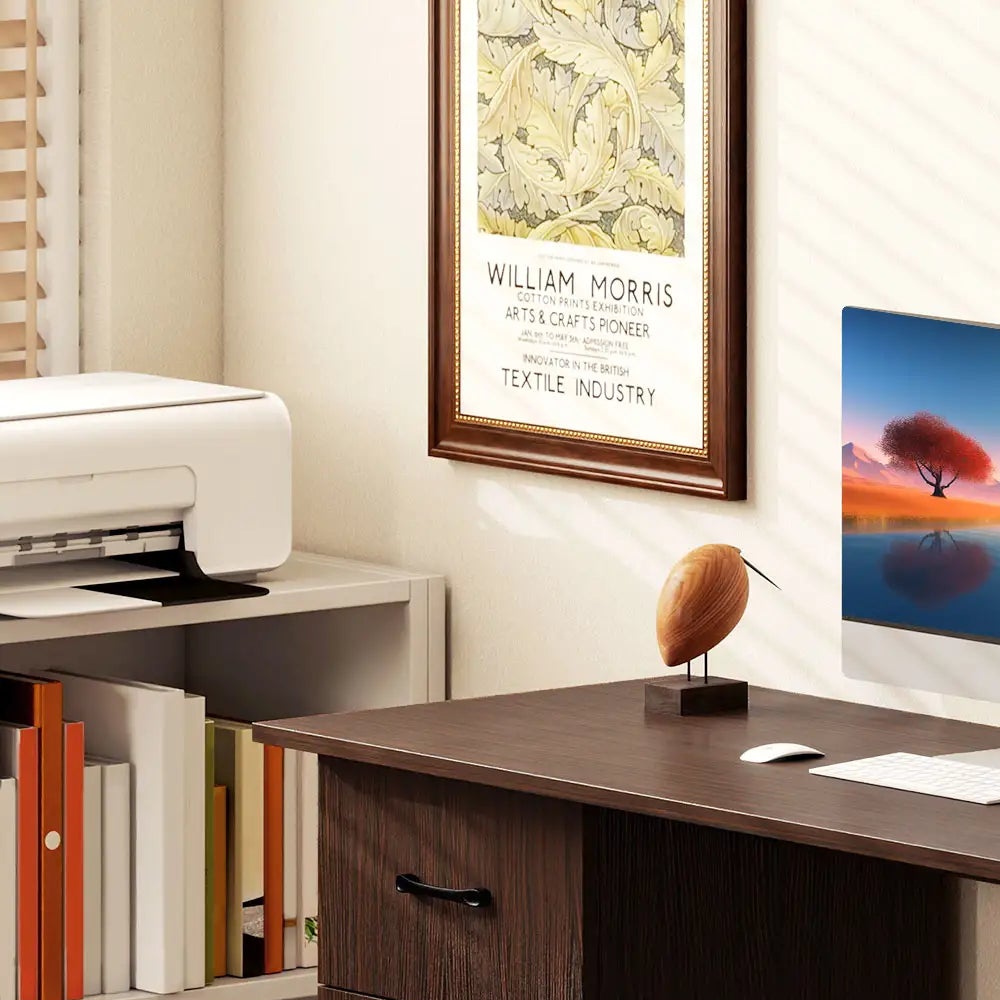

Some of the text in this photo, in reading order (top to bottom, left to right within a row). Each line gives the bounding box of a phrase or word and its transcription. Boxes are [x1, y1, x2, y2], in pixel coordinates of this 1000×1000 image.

[487, 261, 575, 295] WILLIAM
[591, 273, 674, 308] MORRIS
[517, 290, 644, 317] COTTON PRINTS EXHIBITION
[505, 305, 650, 339] ARTS & CRAFTS PIONEER
[522, 353, 630, 377] INNOVATOR IN THE BRITISH
[501, 367, 656, 407] TEXTILE INDUSTRY
